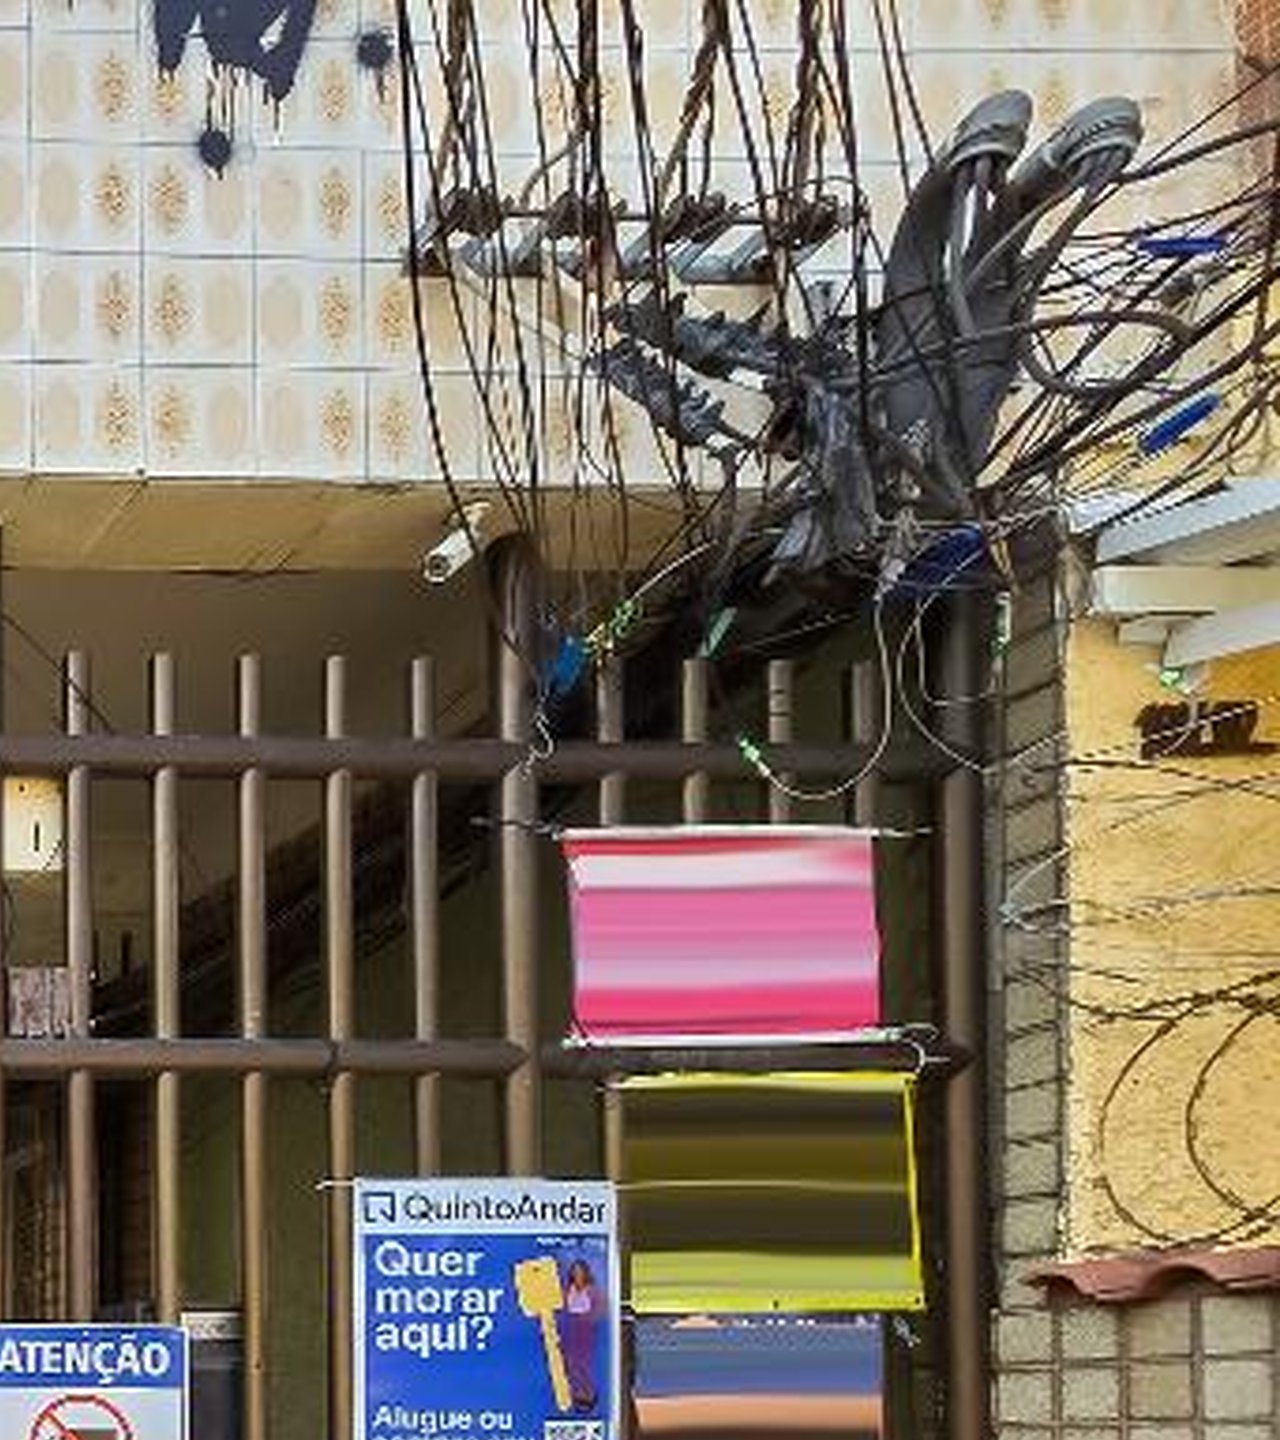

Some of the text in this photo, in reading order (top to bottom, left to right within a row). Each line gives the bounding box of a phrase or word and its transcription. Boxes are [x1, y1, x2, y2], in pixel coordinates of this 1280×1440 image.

[404, 1193, 606, 1224] QuintoAndar
[375, 1240, 485, 1277] Quer
[375, 1287, 503, 1314] morar
[375, 1316, 493, 1358] aqui?
[372, 1405, 512, 1434] Alugue ou
